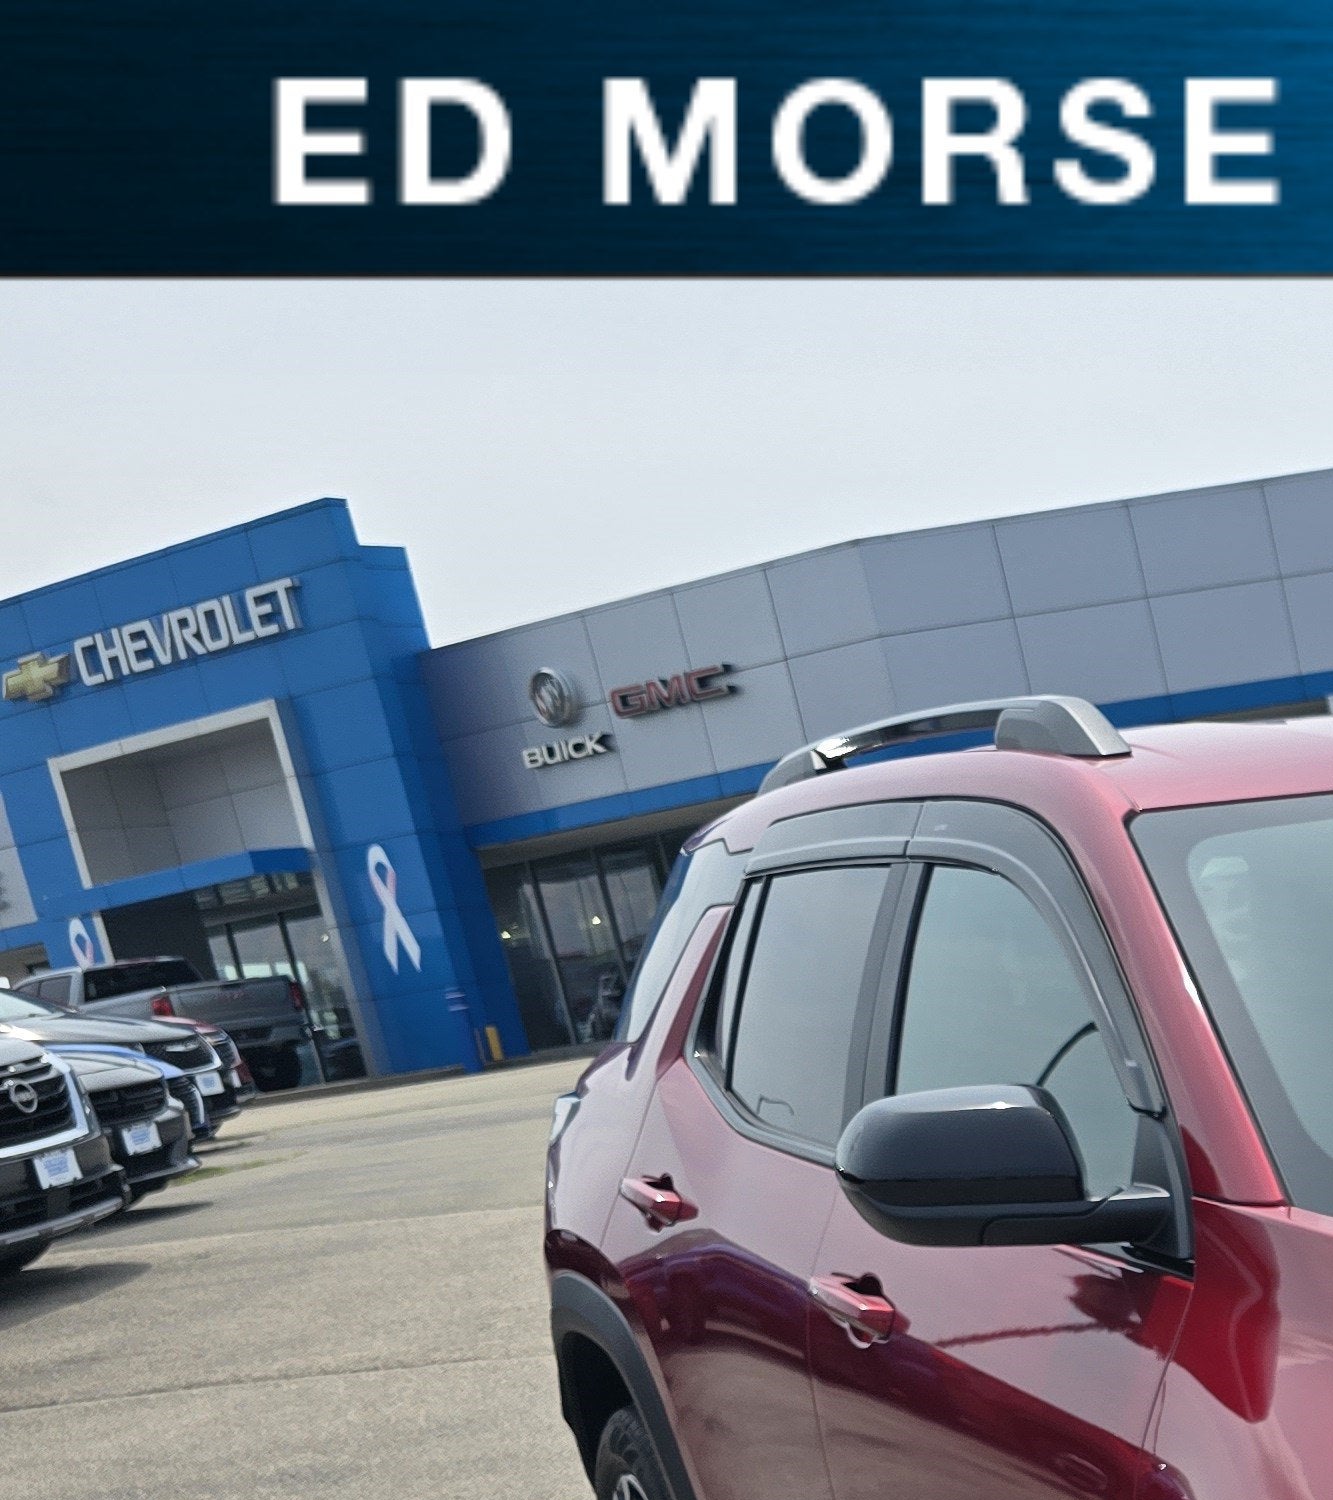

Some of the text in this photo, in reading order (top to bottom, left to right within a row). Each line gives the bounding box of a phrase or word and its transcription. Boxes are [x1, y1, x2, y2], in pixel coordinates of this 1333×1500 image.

[73, 577, 297, 687] CHEVROLET
[609, 664, 730, 719] GMC
[522, 731, 608, 769] BUICK
